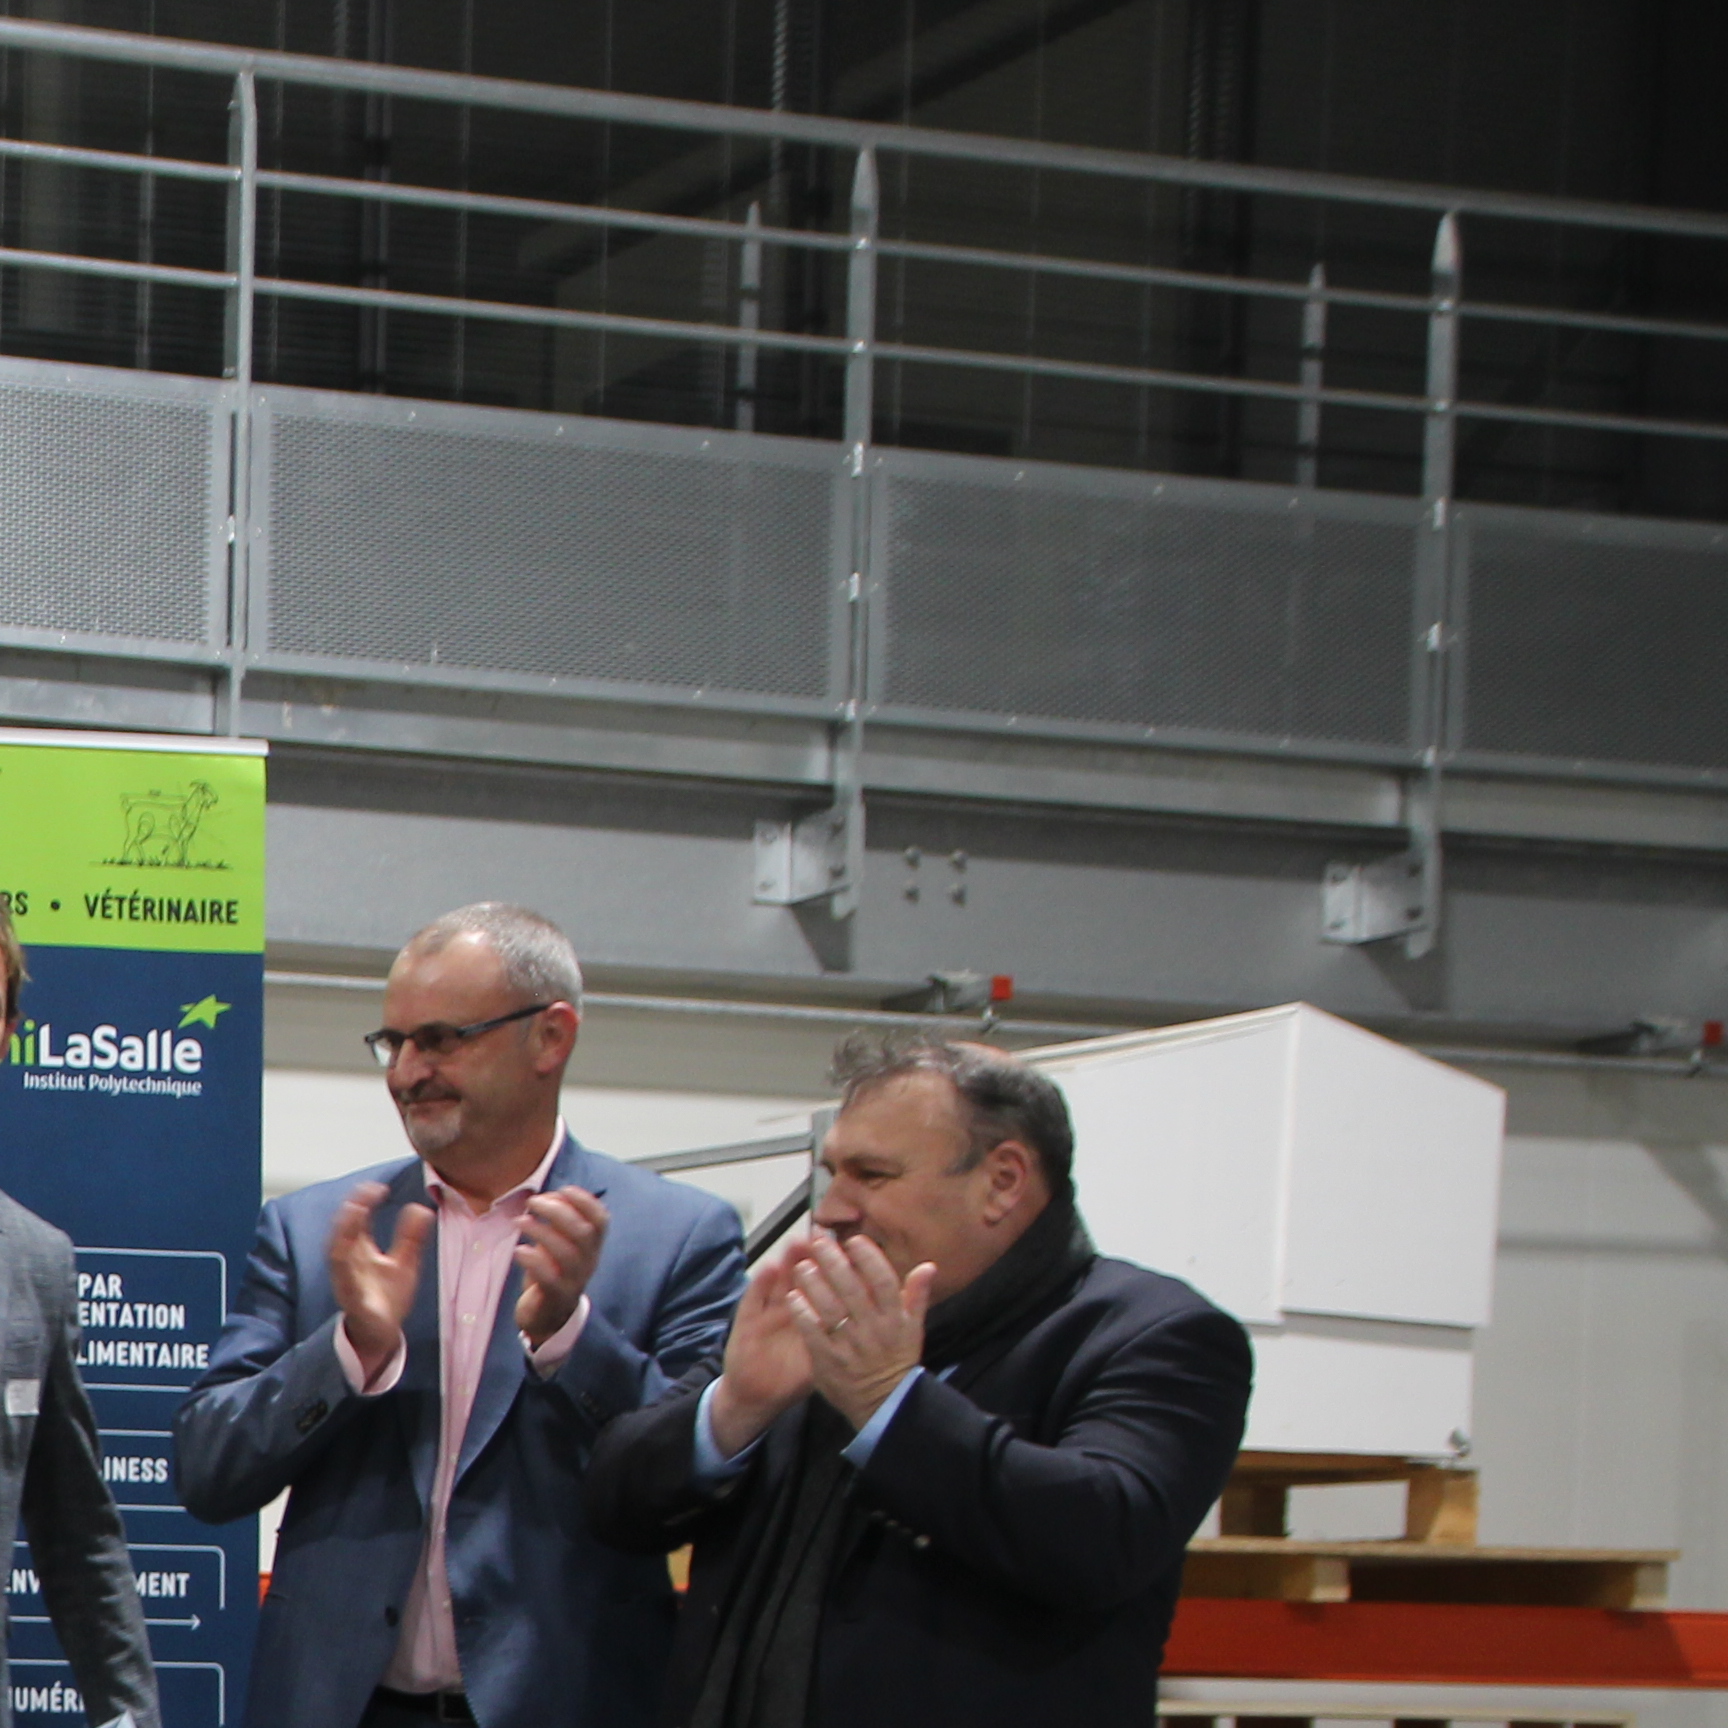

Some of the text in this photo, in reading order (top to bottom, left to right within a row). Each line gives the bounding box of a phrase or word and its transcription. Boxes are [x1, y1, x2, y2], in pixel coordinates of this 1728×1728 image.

[83, 888, 239, 925] VÉTÉRINAIRE
[8, 1019, 202, 1074] iLaSalle
[23, 1071, 202, 1098] Institut Polytechnique
[77, 1272, 123, 1300] PAR
[76, 1300, 185, 1331] ENTATION
[76, 1340, 210, 1370] LIMENTAIRE
[102, 1455, 169, 1484] INESS
